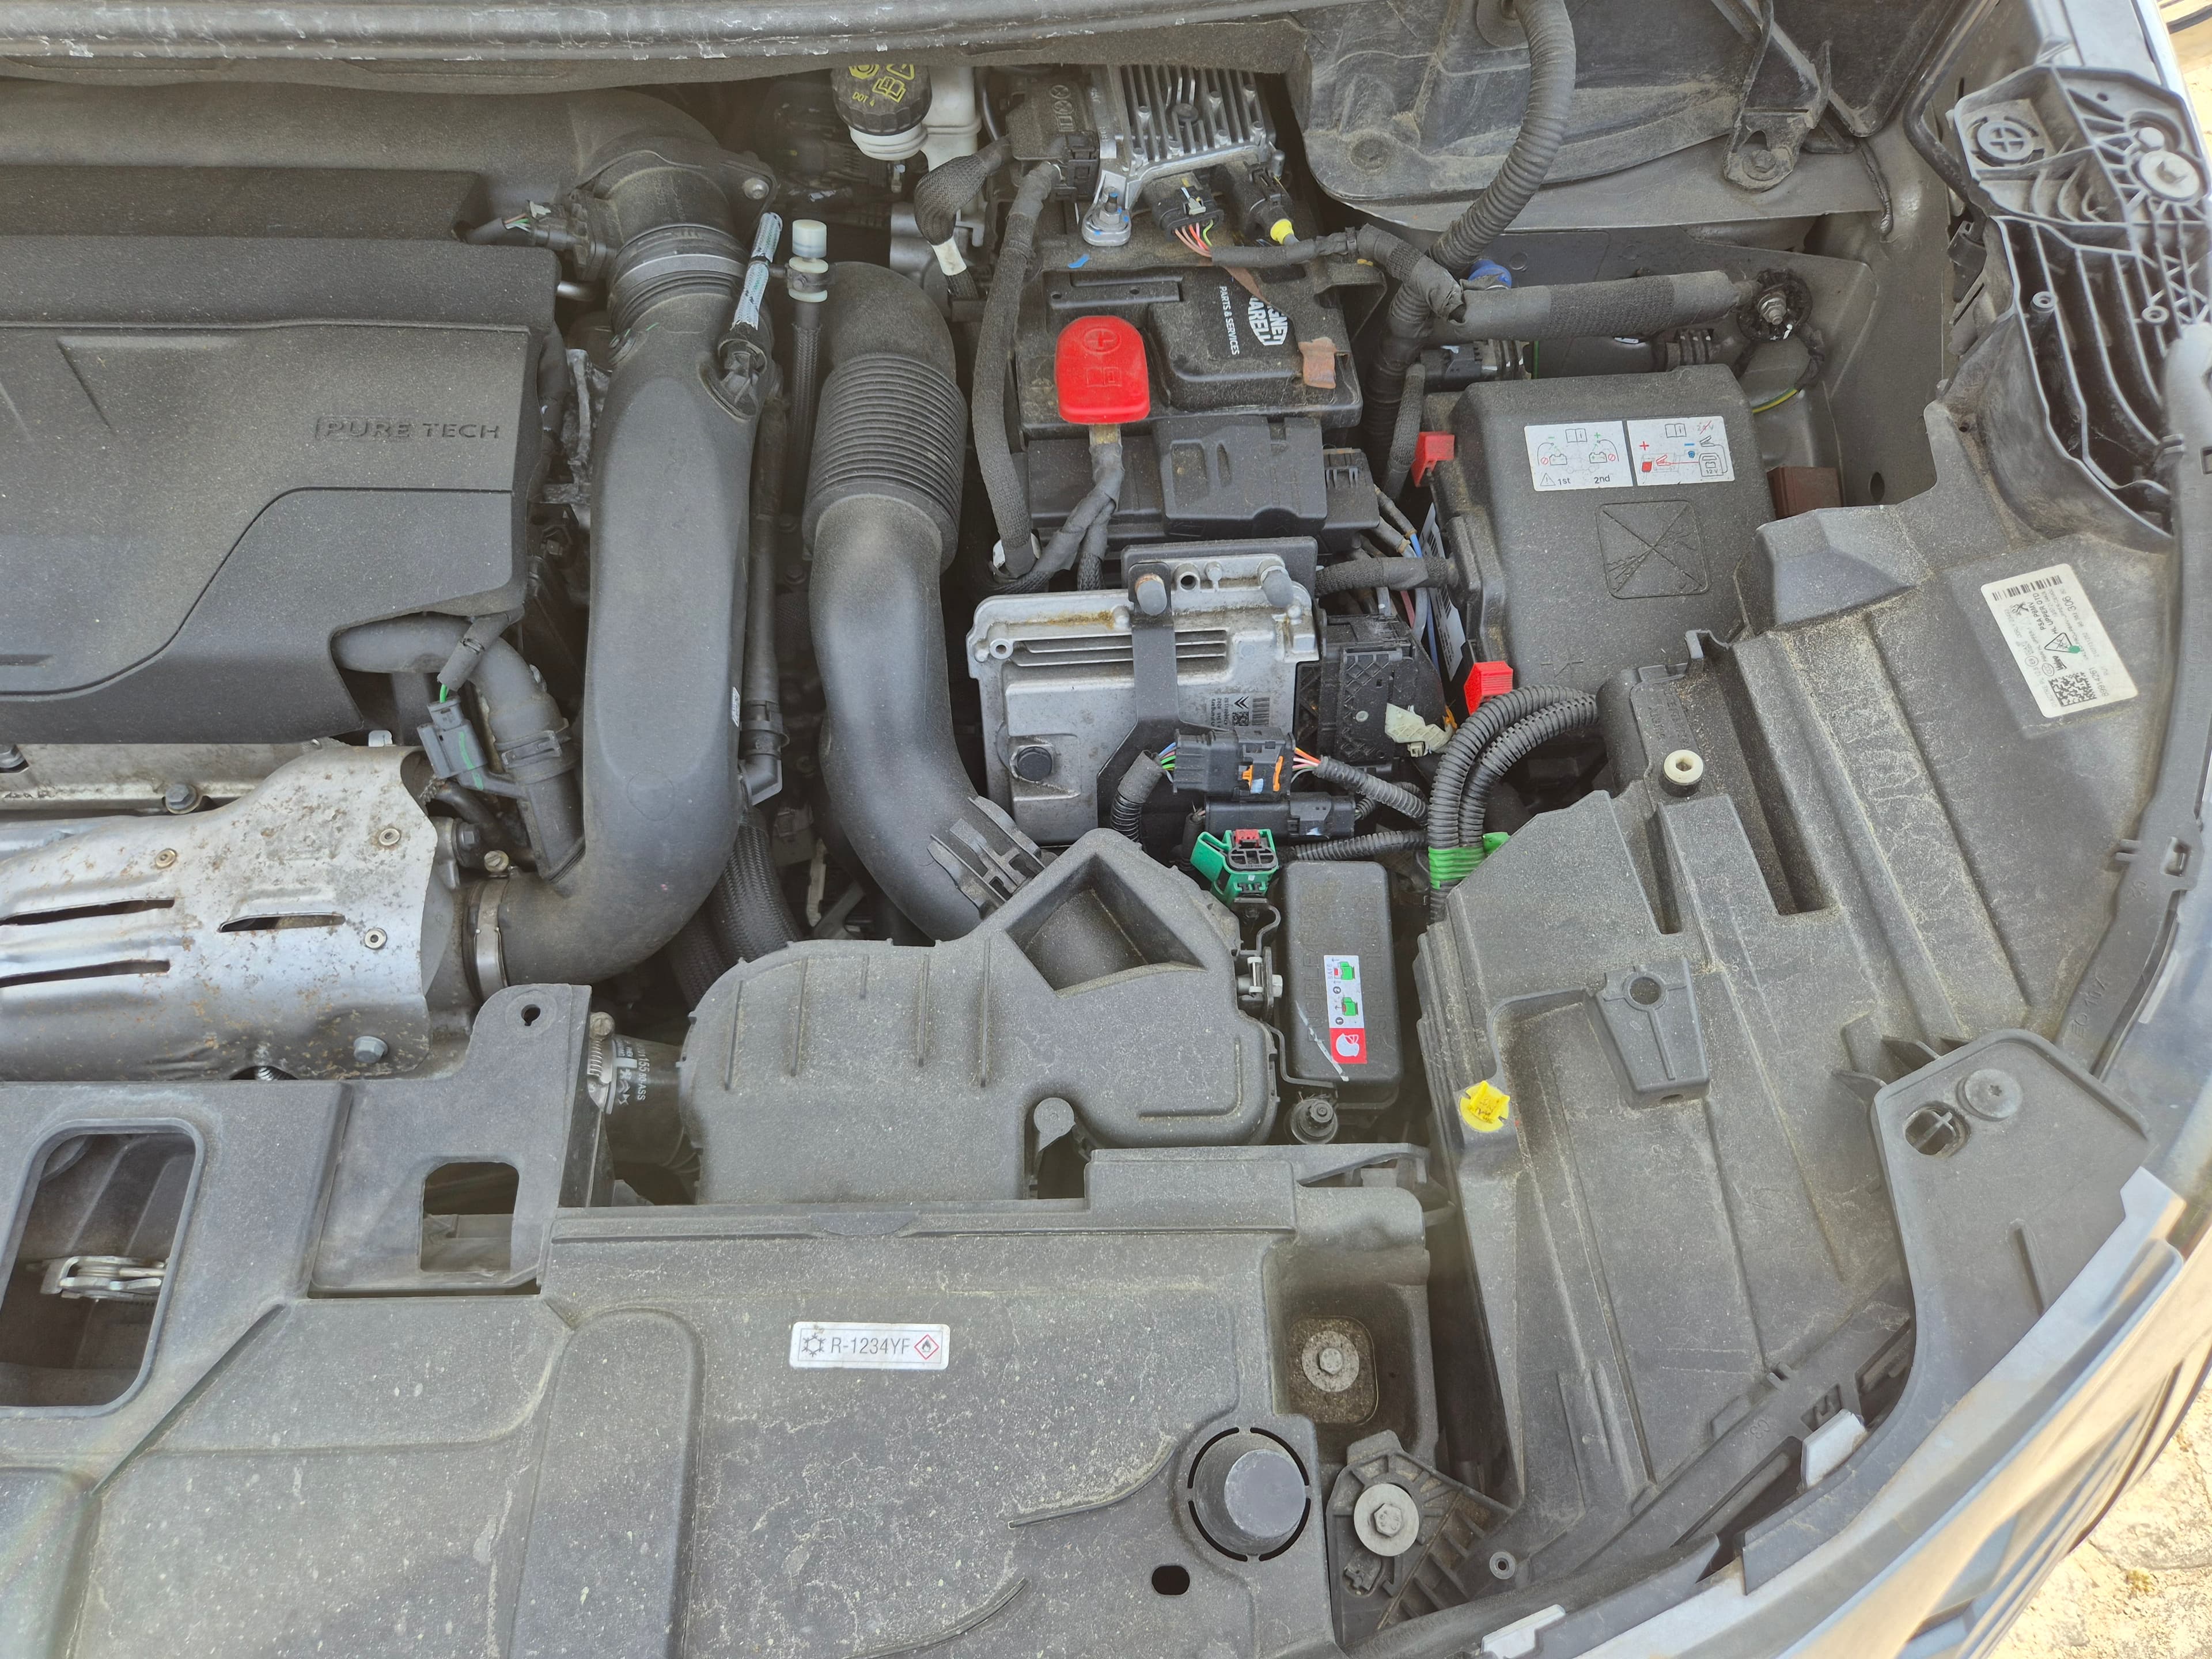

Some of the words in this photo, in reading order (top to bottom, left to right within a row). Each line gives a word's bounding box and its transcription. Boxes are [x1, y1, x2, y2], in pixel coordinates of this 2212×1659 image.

[852, 92, 870, 103] DOT
[1219, 286, 1231, 310] PARTS
[1225, 317, 1240, 355] SERVICES
[326, 421, 412, 438] PURE
[422, 422, 501, 439] TECH
[1558, 476, 1571, 485] 1st
[1594, 475, 1611, 484] 2nd
[2026, 600, 2040, 618] P8MV
[2061, 595, 2077, 612] 306
[2035, 617, 2047, 630] PSA
[2038, 605, 2054, 626] UPPER
[2050, 626, 2058, 634] HL
[2050, 654, 2064, 671] Valeo
[638, 1058, 650, 1072] 155
[637, 1073, 647, 1101] 80-ASS
[830, 1336, 911, 1355] R-1234YF
